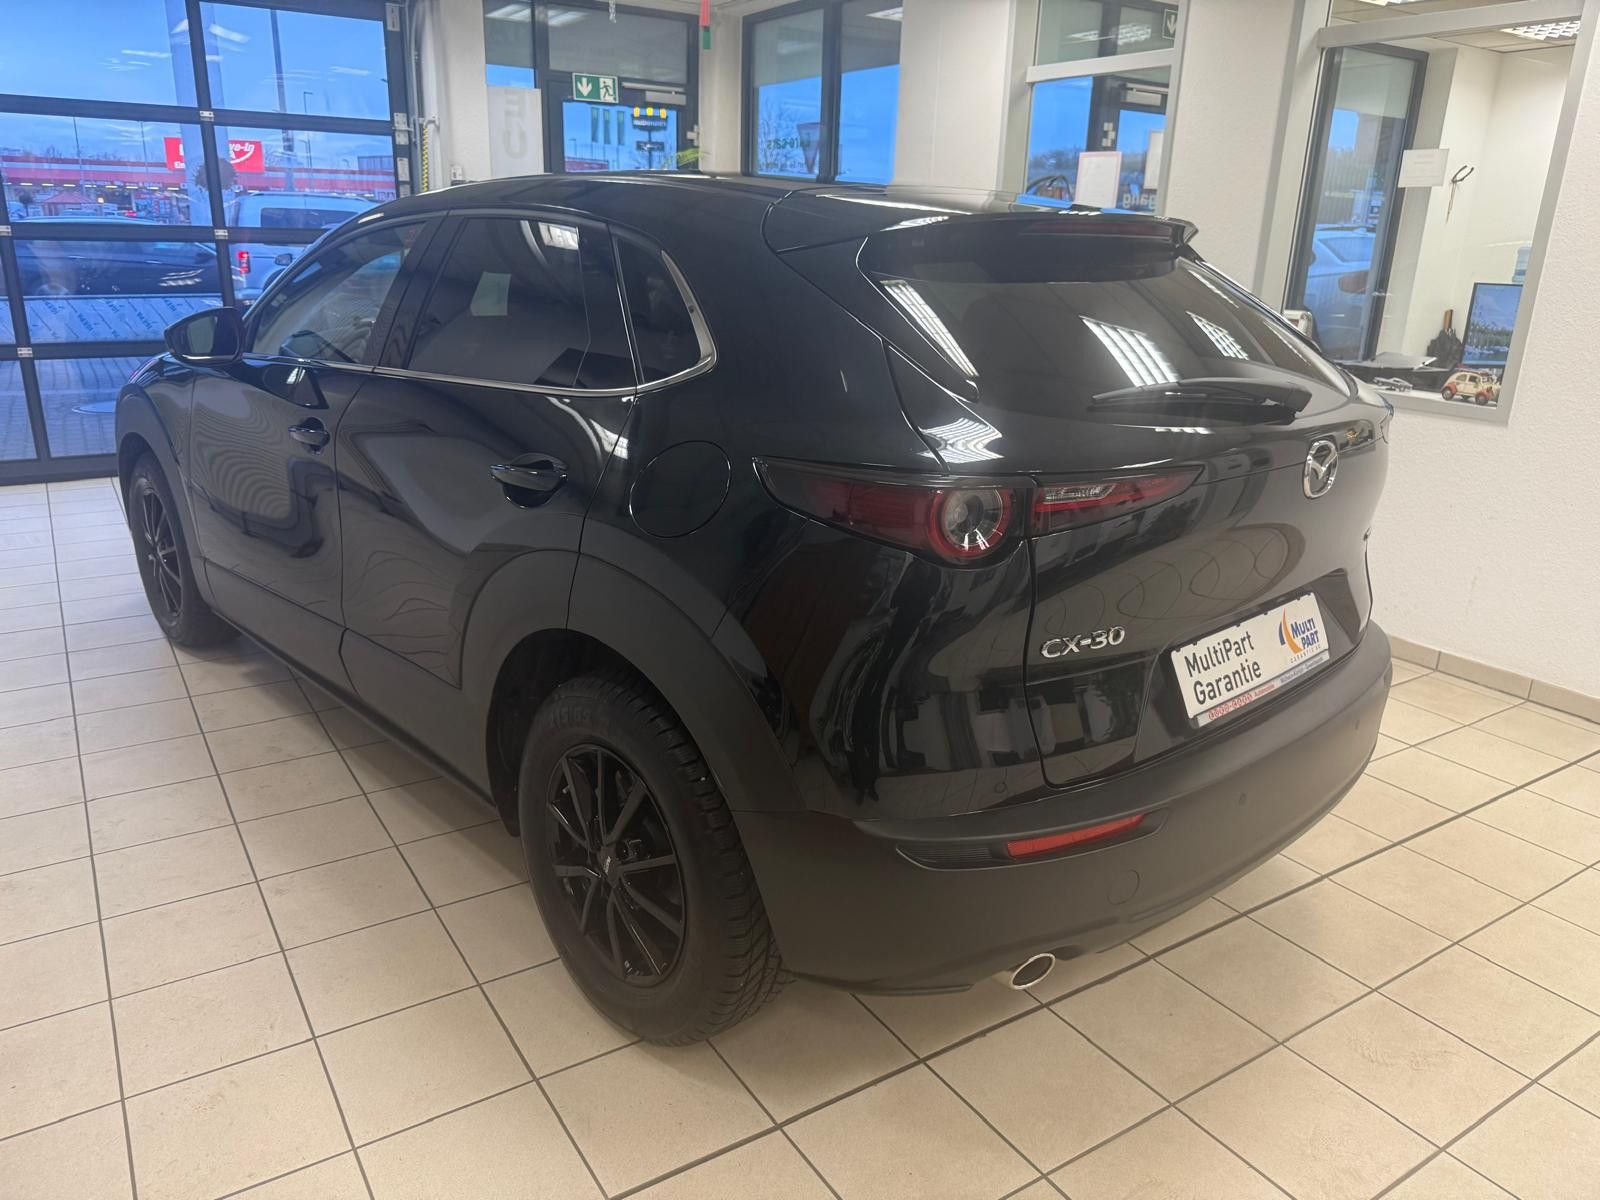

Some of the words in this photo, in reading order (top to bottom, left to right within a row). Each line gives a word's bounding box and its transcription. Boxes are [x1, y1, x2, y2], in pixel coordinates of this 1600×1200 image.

[1040, 625, 1126, 659] CX-30
[1291, 617, 1316, 639] MULTI
[1301, 630, 1319, 650] PART
[1184, 631, 1255, 678] MultiPart
[1193, 658, 1263, 706] Garantie
